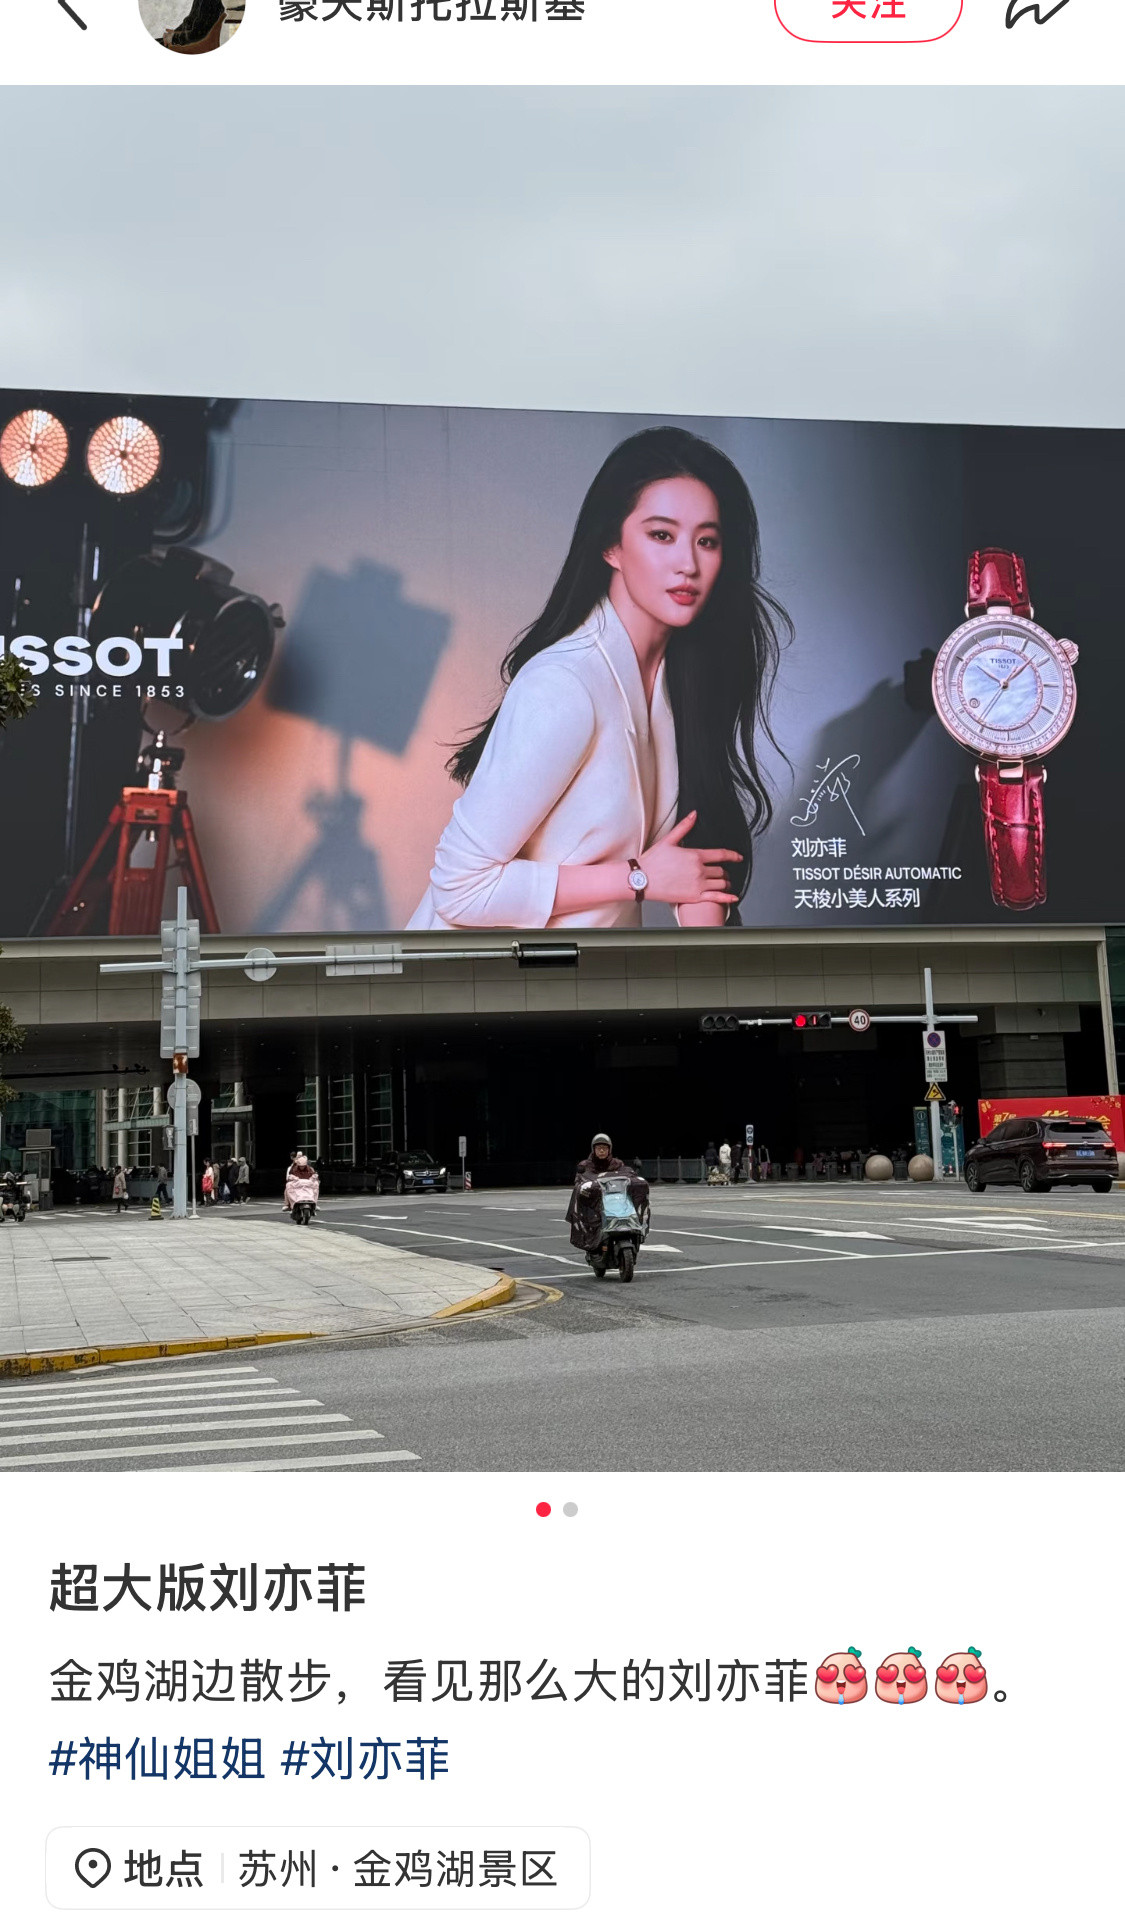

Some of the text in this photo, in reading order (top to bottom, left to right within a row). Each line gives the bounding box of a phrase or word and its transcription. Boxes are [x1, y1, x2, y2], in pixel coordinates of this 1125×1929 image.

[0, 635, 183, 677] SSOT
[55, 684, 121, 697] SINCE
[135, 685, 185, 698] 1853
[791, 838, 847, 858] 刘亦菲
[793, 864, 962, 880] TISSOT DÉSIR AUTOMATIC
[794, 888, 920, 909] 天梭小美人系列
[854, 1015, 866, 1025] 40
